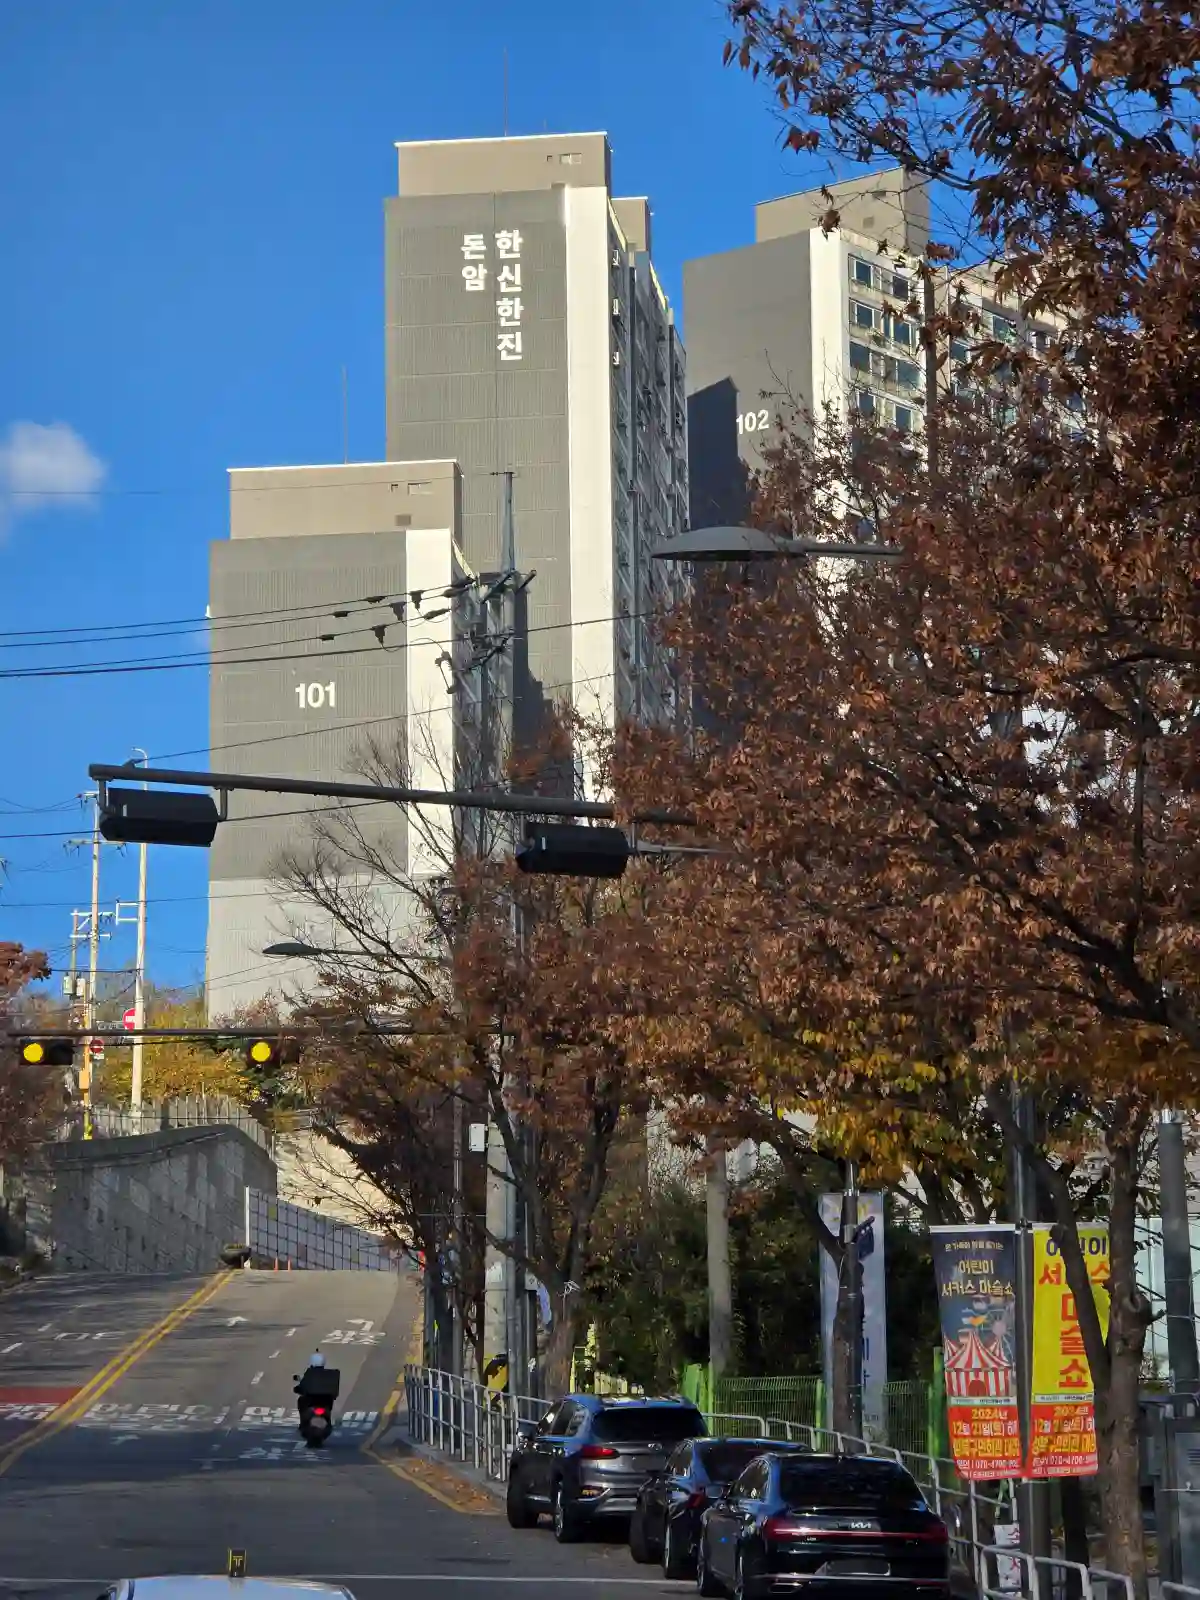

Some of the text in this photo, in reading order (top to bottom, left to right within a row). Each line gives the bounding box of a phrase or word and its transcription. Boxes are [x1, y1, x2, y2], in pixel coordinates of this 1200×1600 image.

[461, 233, 488, 291] 돈암
[494, 229, 524, 361] 한신한진
[736, 409, 769, 434] 102
[295, 681, 335, 708] 101
[941, 1279, 977, 1297] 서커스
